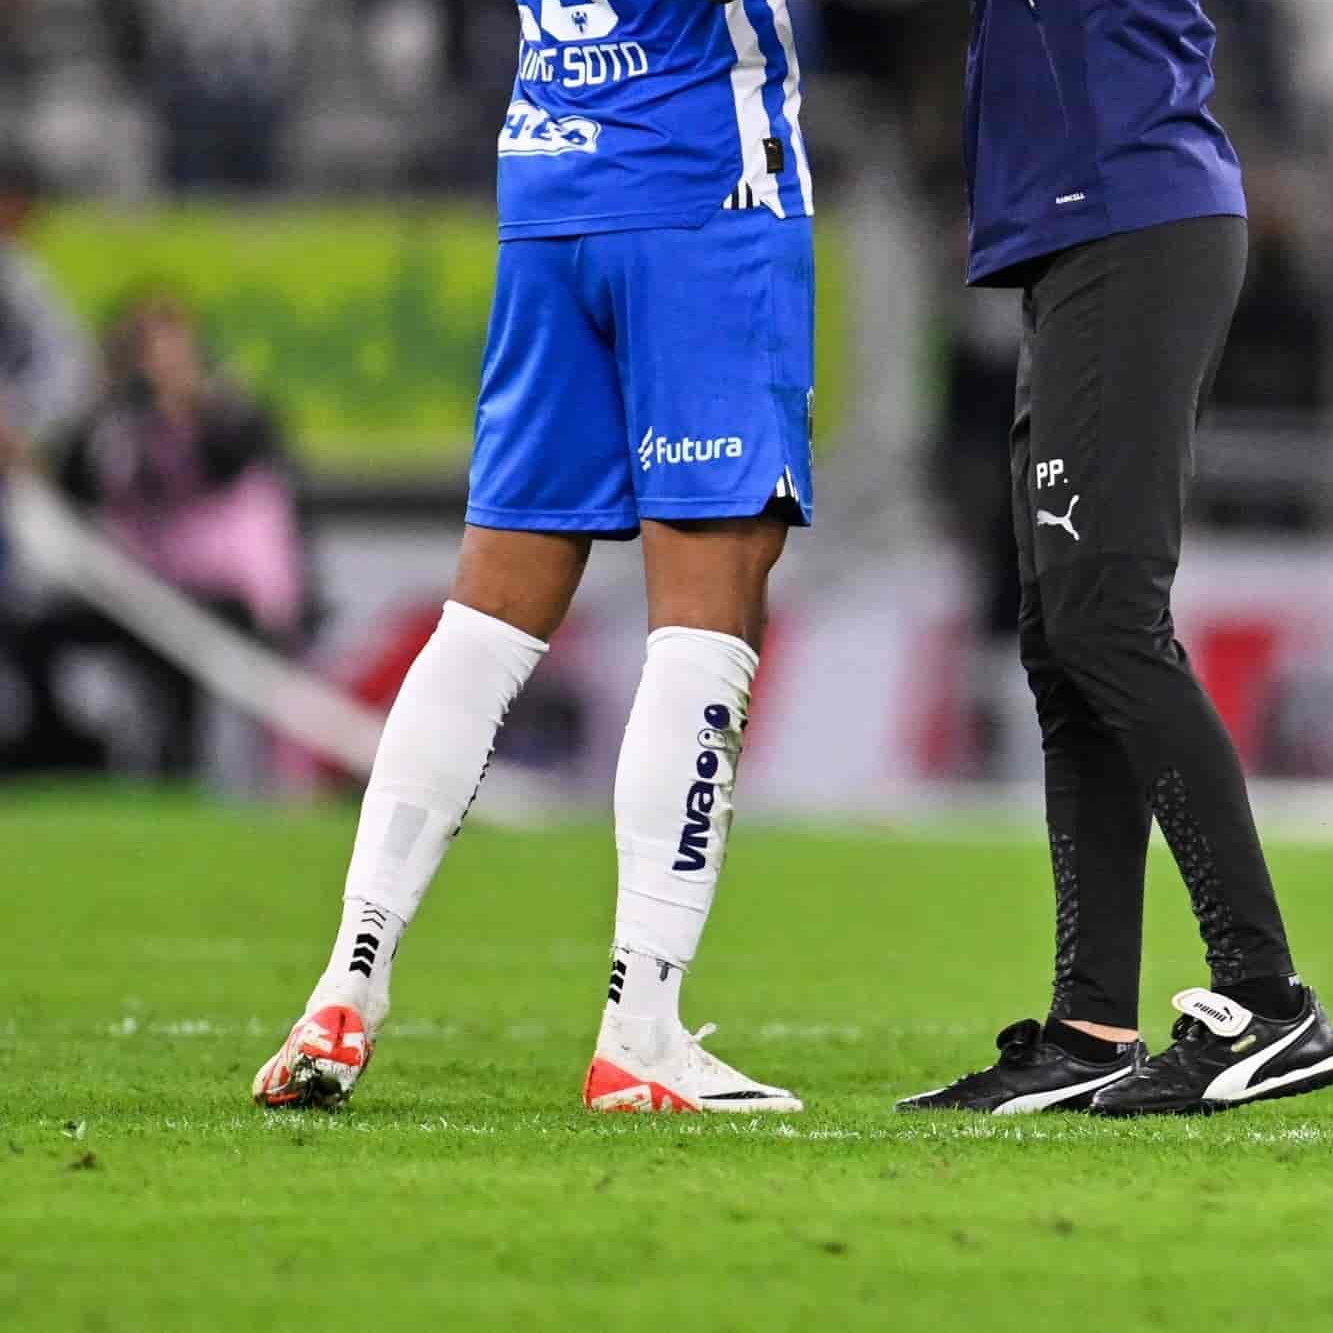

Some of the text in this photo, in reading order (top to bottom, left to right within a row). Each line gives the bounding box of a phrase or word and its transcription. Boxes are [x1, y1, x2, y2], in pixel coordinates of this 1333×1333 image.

[562, 41, 648, 88] SOTO
[656, 435, 743, 464] Futura
[671, 781, 715, 871] viva
